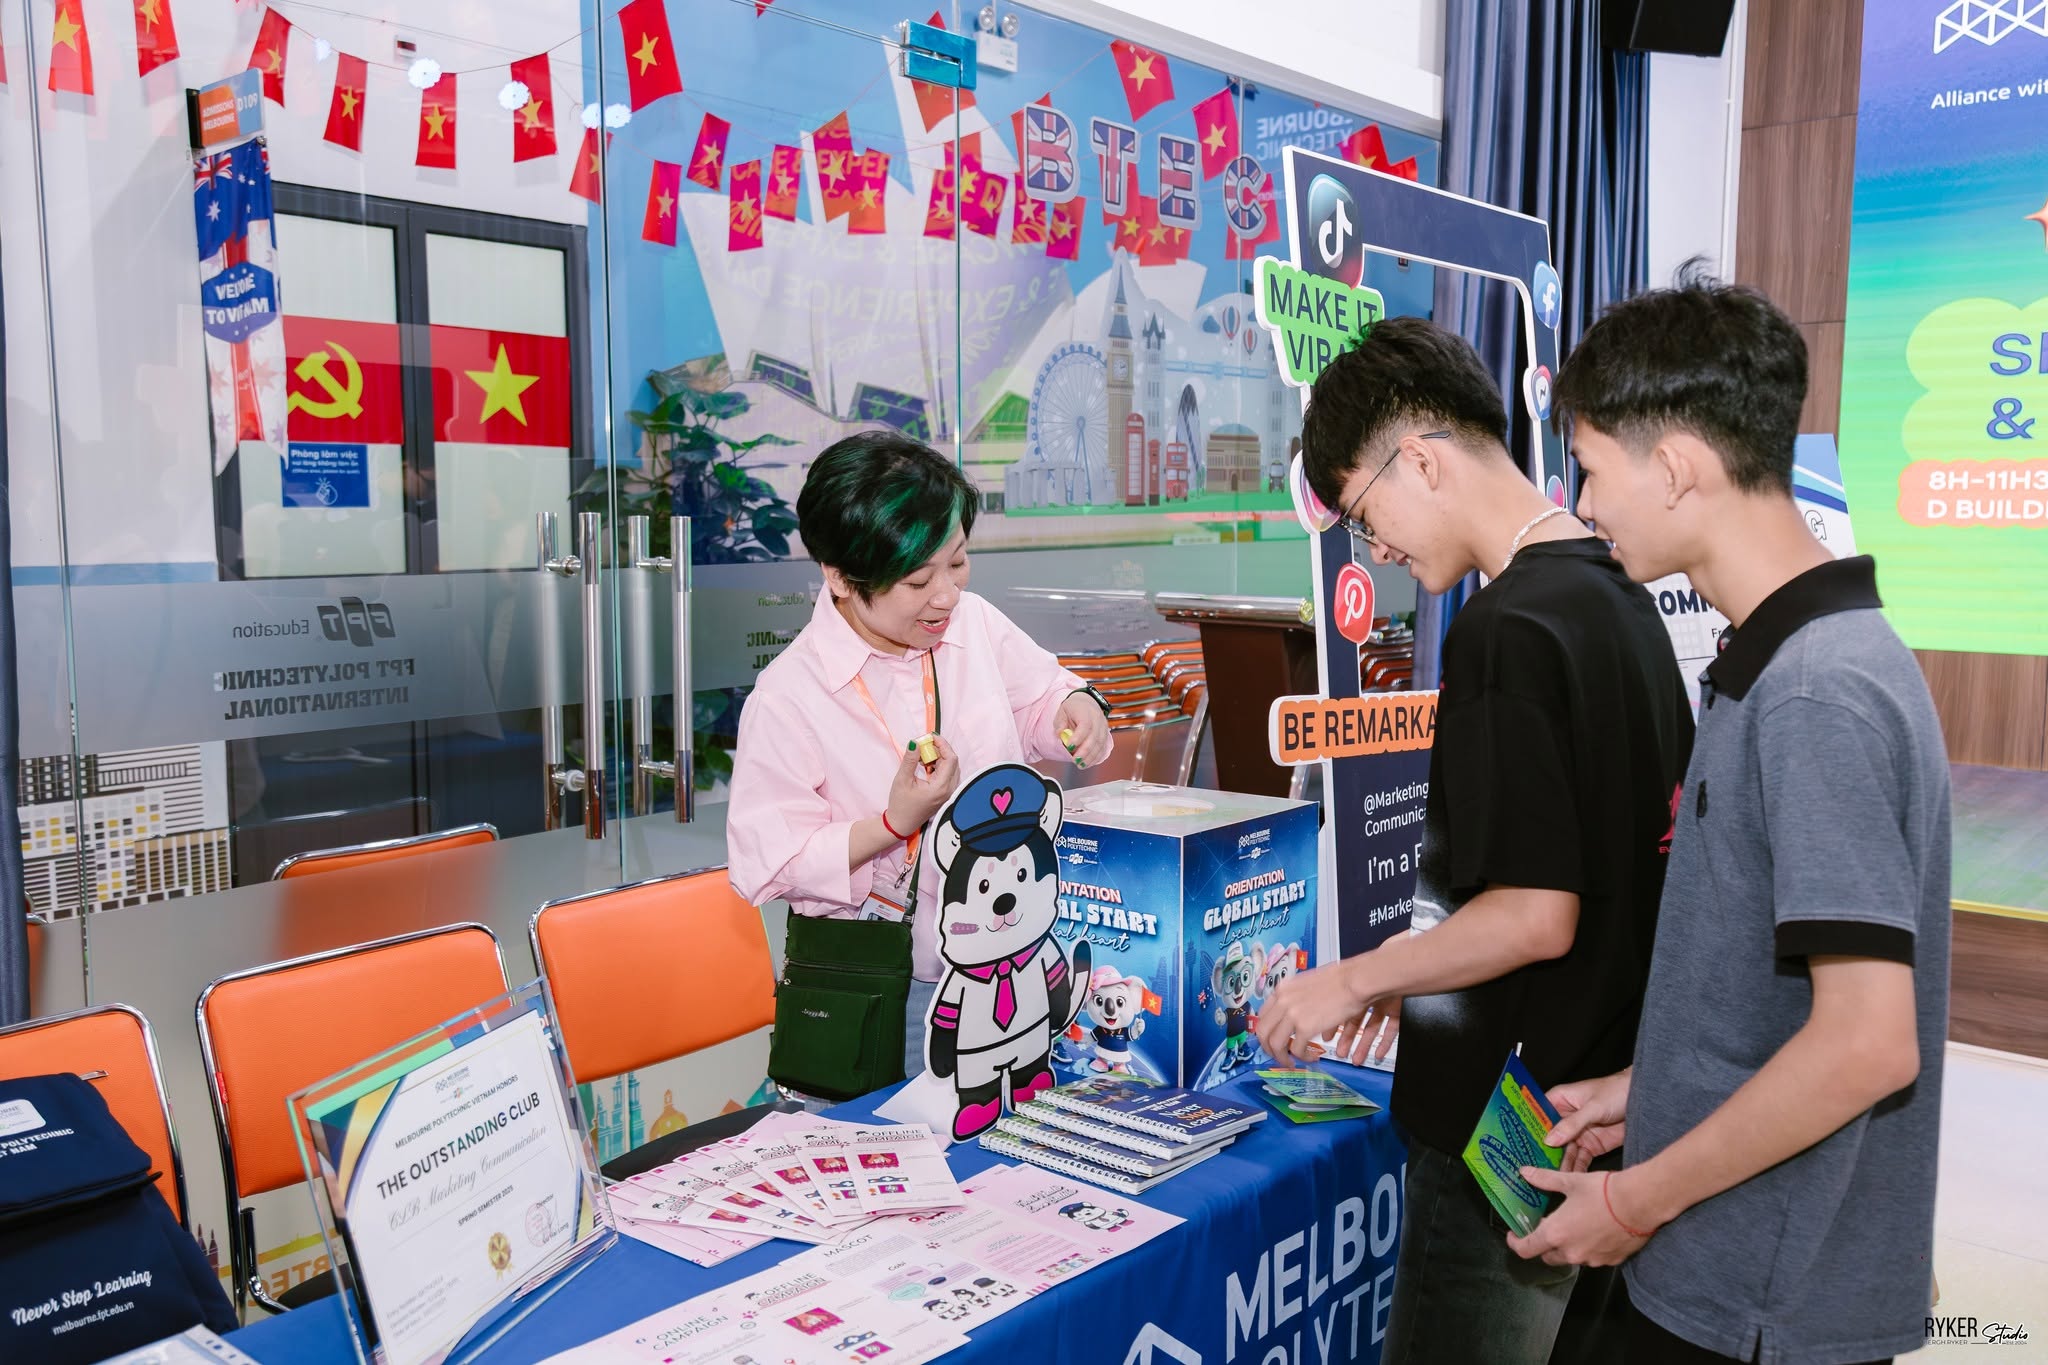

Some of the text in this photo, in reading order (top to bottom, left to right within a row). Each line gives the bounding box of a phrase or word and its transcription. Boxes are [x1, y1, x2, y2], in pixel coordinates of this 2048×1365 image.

[1930, 87, 2011, 109] Alliance
[1270, 273, 1349, 333] MAKE
[1287, 329, 1346, 374] VIR
[1986, 397, 2035, 440] &
[1927, 499, 1948, 519] D
[1284, 711, 1316, 751] BE
[1364, 781, 1429, 816] @Marketing
[1224, 868, 1285, 899] ORIENTATION
[1368, 855, 1395, 885] I'm
[1400, 853, 1409, 873] a
[1086, 903, 1157, 936] START
[1203, 879, 1306, 932] GLOBAL START
[395, 1124, 432, 1149] MELBOURNE
[432, 1101, 472, 1129] POLYTECHNIC
[471, 1086, 496, 1108] VIETNAM
[1, 1128, 74, 1149] POLYTECHNIC
[11, 1143, 38, 1155] NAM
[377, 1092, 540, 1200] THE OUTSTANDING CLUB
[823, 1234, 873, 1258] MASCOT
[1226, 1162, 1407, 1365] MELBO
[11, 1270, 152, 1327] Never Stop Learning
[757, 1276, 827, 1308] CAMPAIGN
[763, 1272, 818, 1297] OFFLINE
[652, 1315, 729, 1351] CAMPAIGN
[656, 1315, 709, 1342] ONLINE
